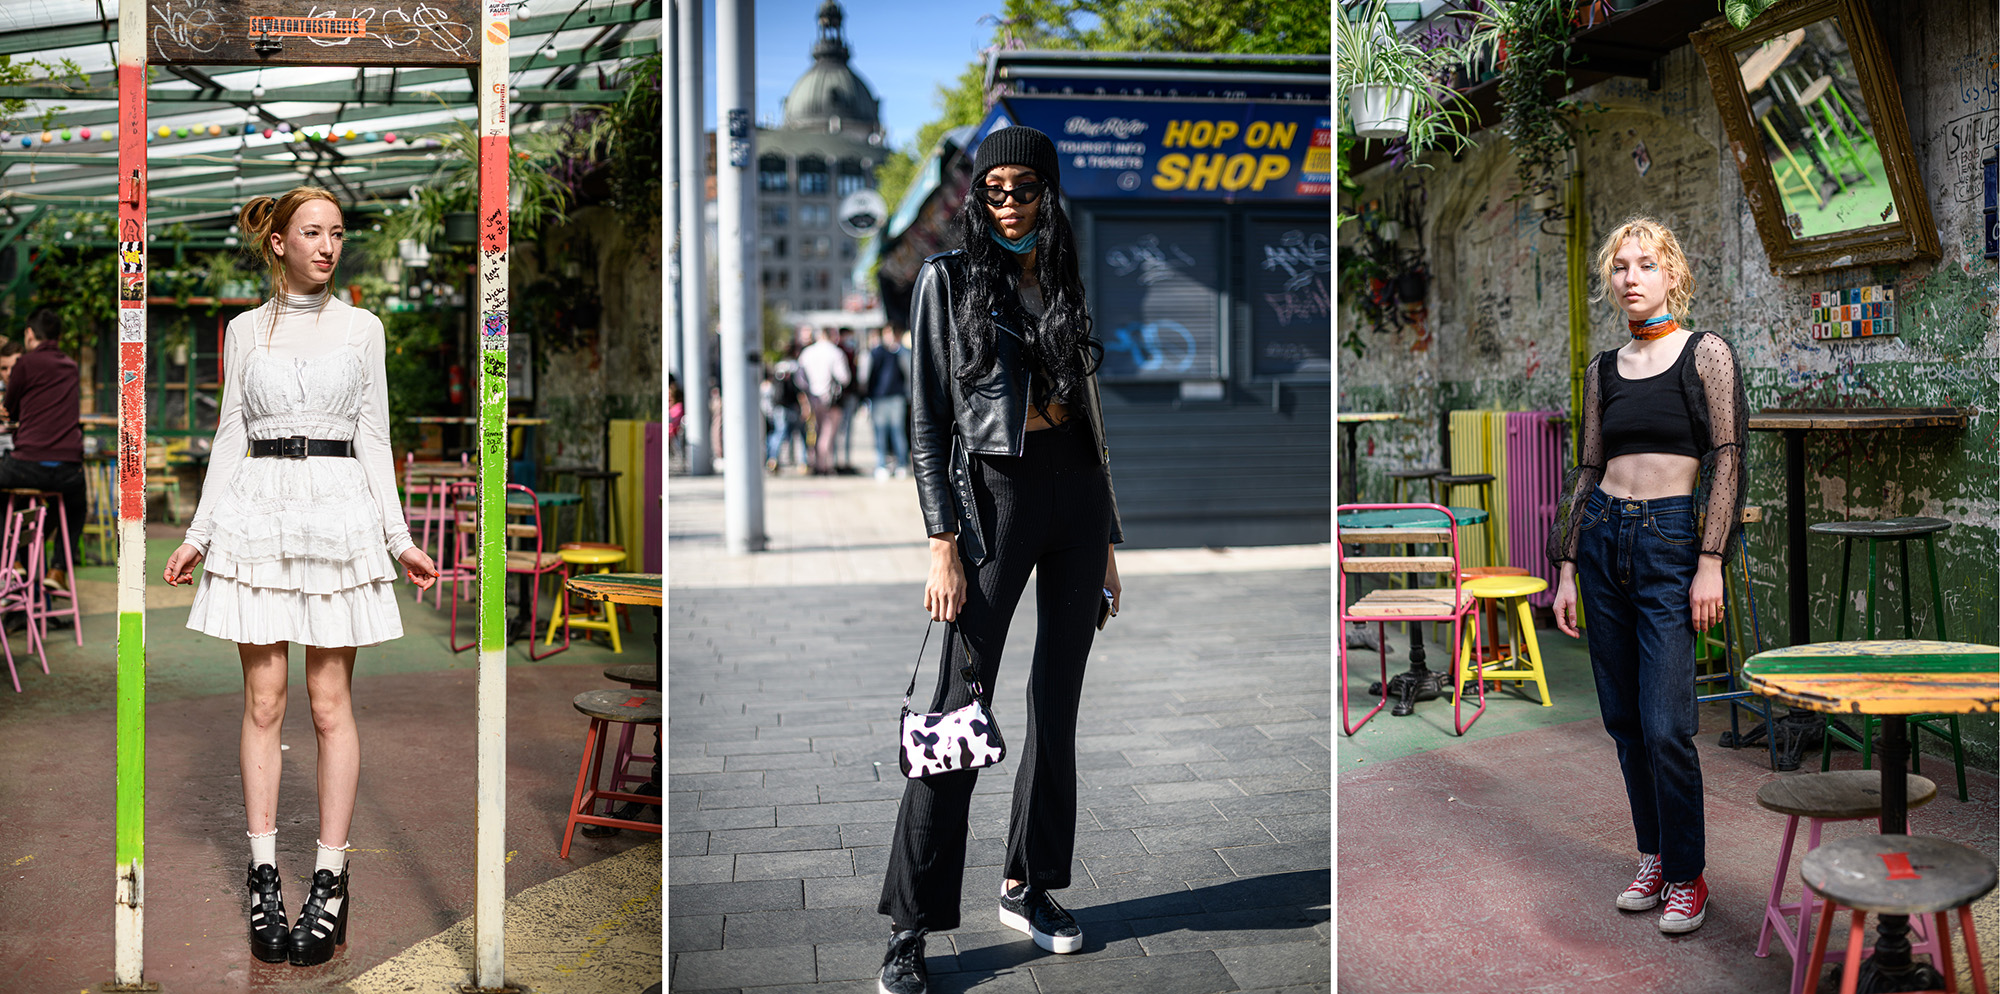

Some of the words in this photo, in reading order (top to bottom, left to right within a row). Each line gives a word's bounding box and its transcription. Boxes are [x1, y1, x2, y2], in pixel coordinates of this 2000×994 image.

[1161, 120, 1239, 148] HOP
[1244, 121, 1298, 149] ON
[1152, 153, 1291, 191] SHOP
